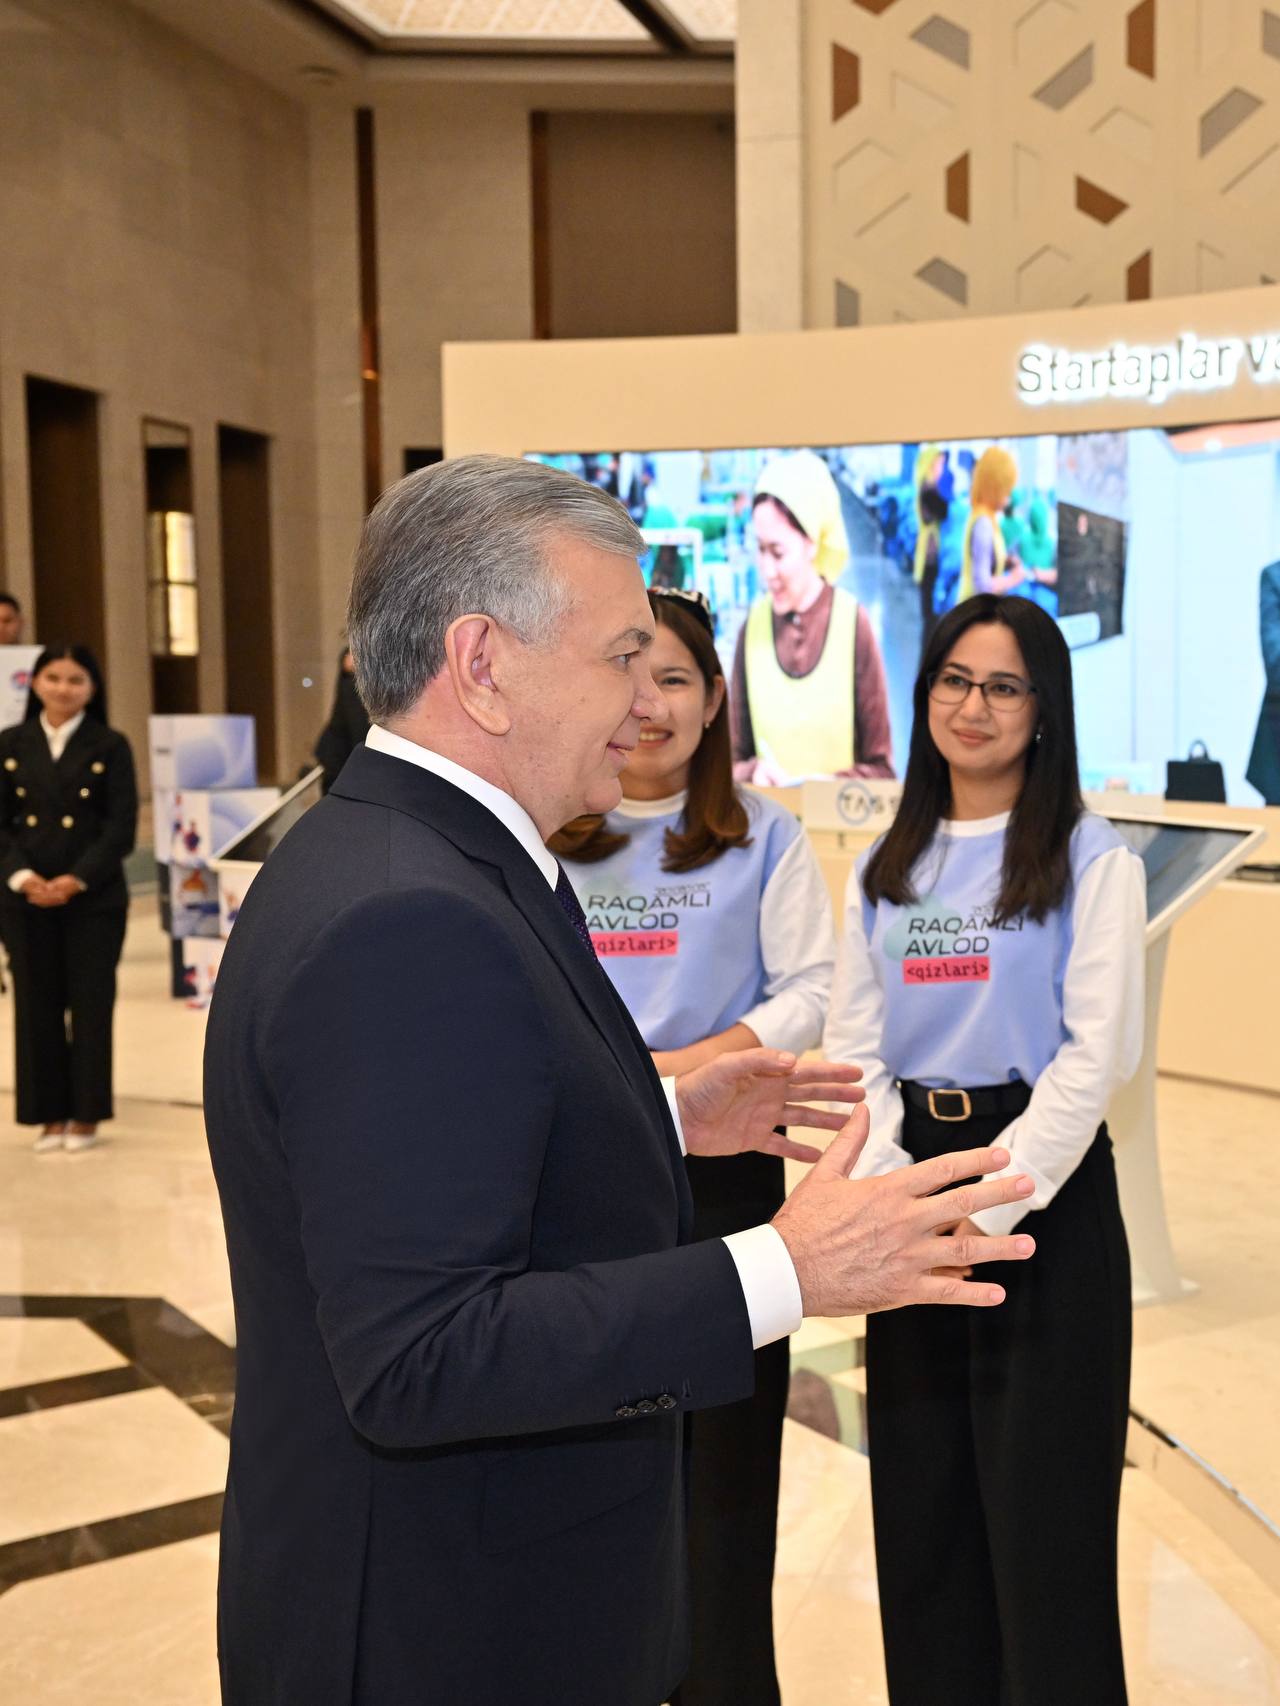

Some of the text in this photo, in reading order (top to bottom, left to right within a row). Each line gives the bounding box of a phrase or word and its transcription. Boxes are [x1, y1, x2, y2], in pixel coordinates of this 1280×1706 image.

[1017, 336, 1233, 398] Startaplar
[587, 893, 711, 913] RAQAMLI
[586, 912, 680, 931] AVLOD
[595, 937, 676, 955] qizlari>
[904, 936, 991, 957] AVLOD
[906, 962, 989, 982] <qizlari>
